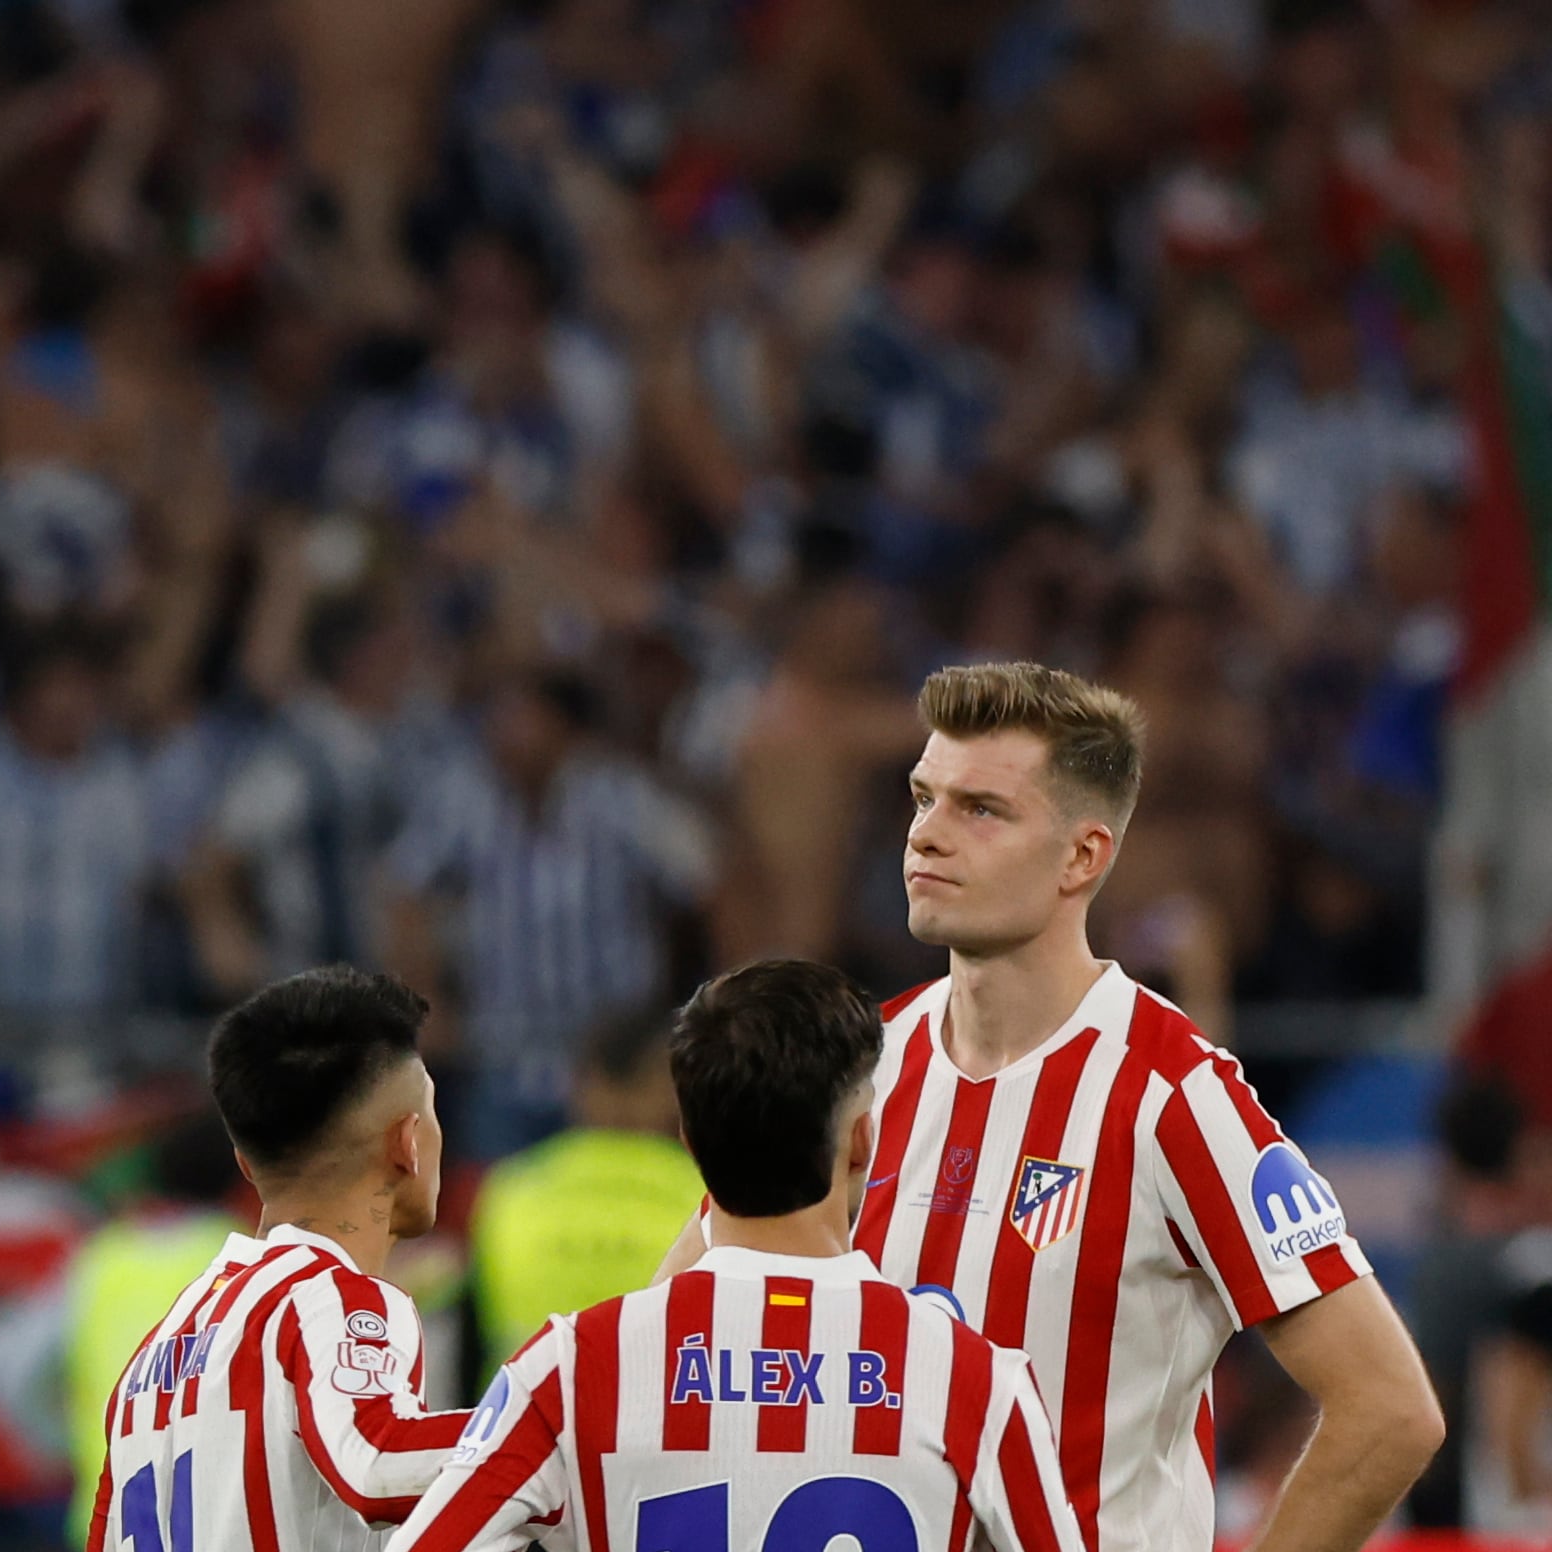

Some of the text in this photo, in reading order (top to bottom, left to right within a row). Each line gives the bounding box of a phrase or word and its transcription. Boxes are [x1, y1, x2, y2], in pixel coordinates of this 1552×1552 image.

[1270, 1216, 1345, 1262] kraken
[671, 1332, 901, 1409] ÁLEX B.
